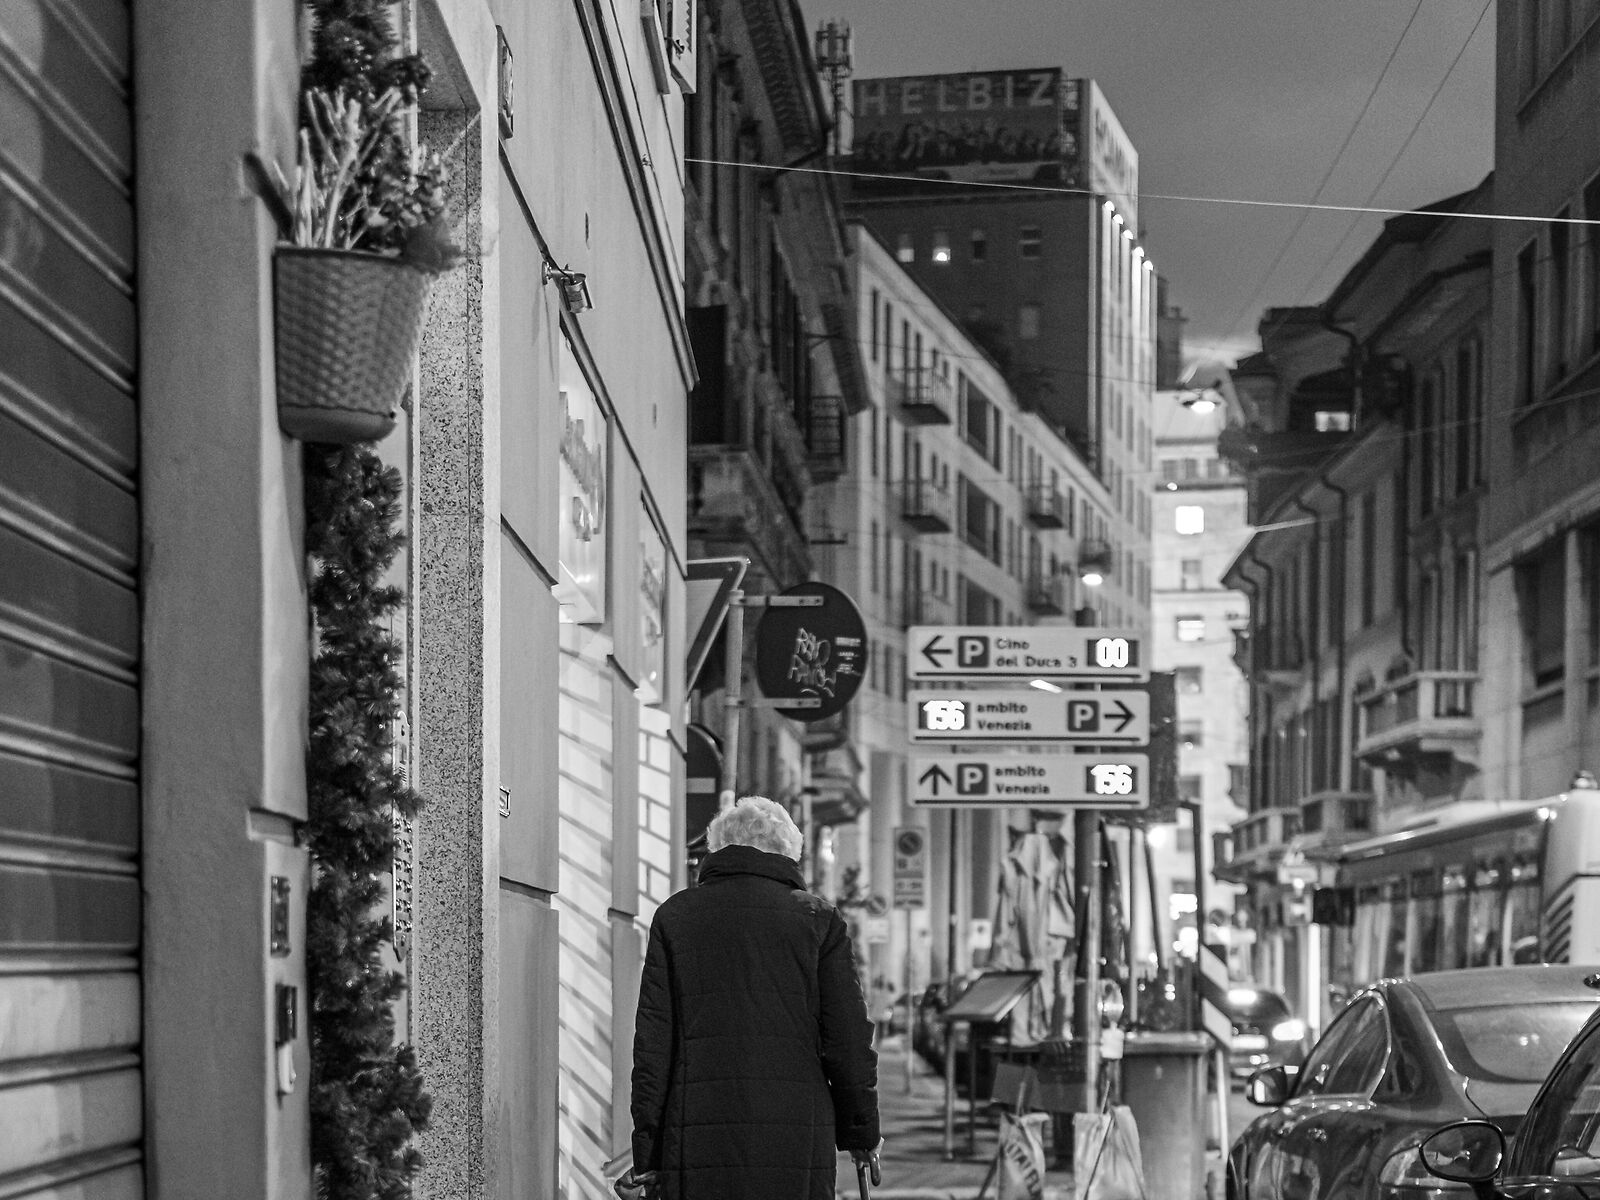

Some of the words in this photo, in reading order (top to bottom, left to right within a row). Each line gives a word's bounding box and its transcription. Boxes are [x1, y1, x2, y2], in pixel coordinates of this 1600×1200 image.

[858, 73, 1054, 117] HELBIZ
[995, 638, 1030, 650] Cino
[995, 655, 1018, 668] del
[1025, 656, 1062, 668] Duca
[1068, 656, 1078, 668] 3
[976, 702, 1029, 714] ambito
[976, 719, 1032, 732] Venezia
[995, 765, 1046, 778] ambito
[995, 782, 1050, 795] Venezia
